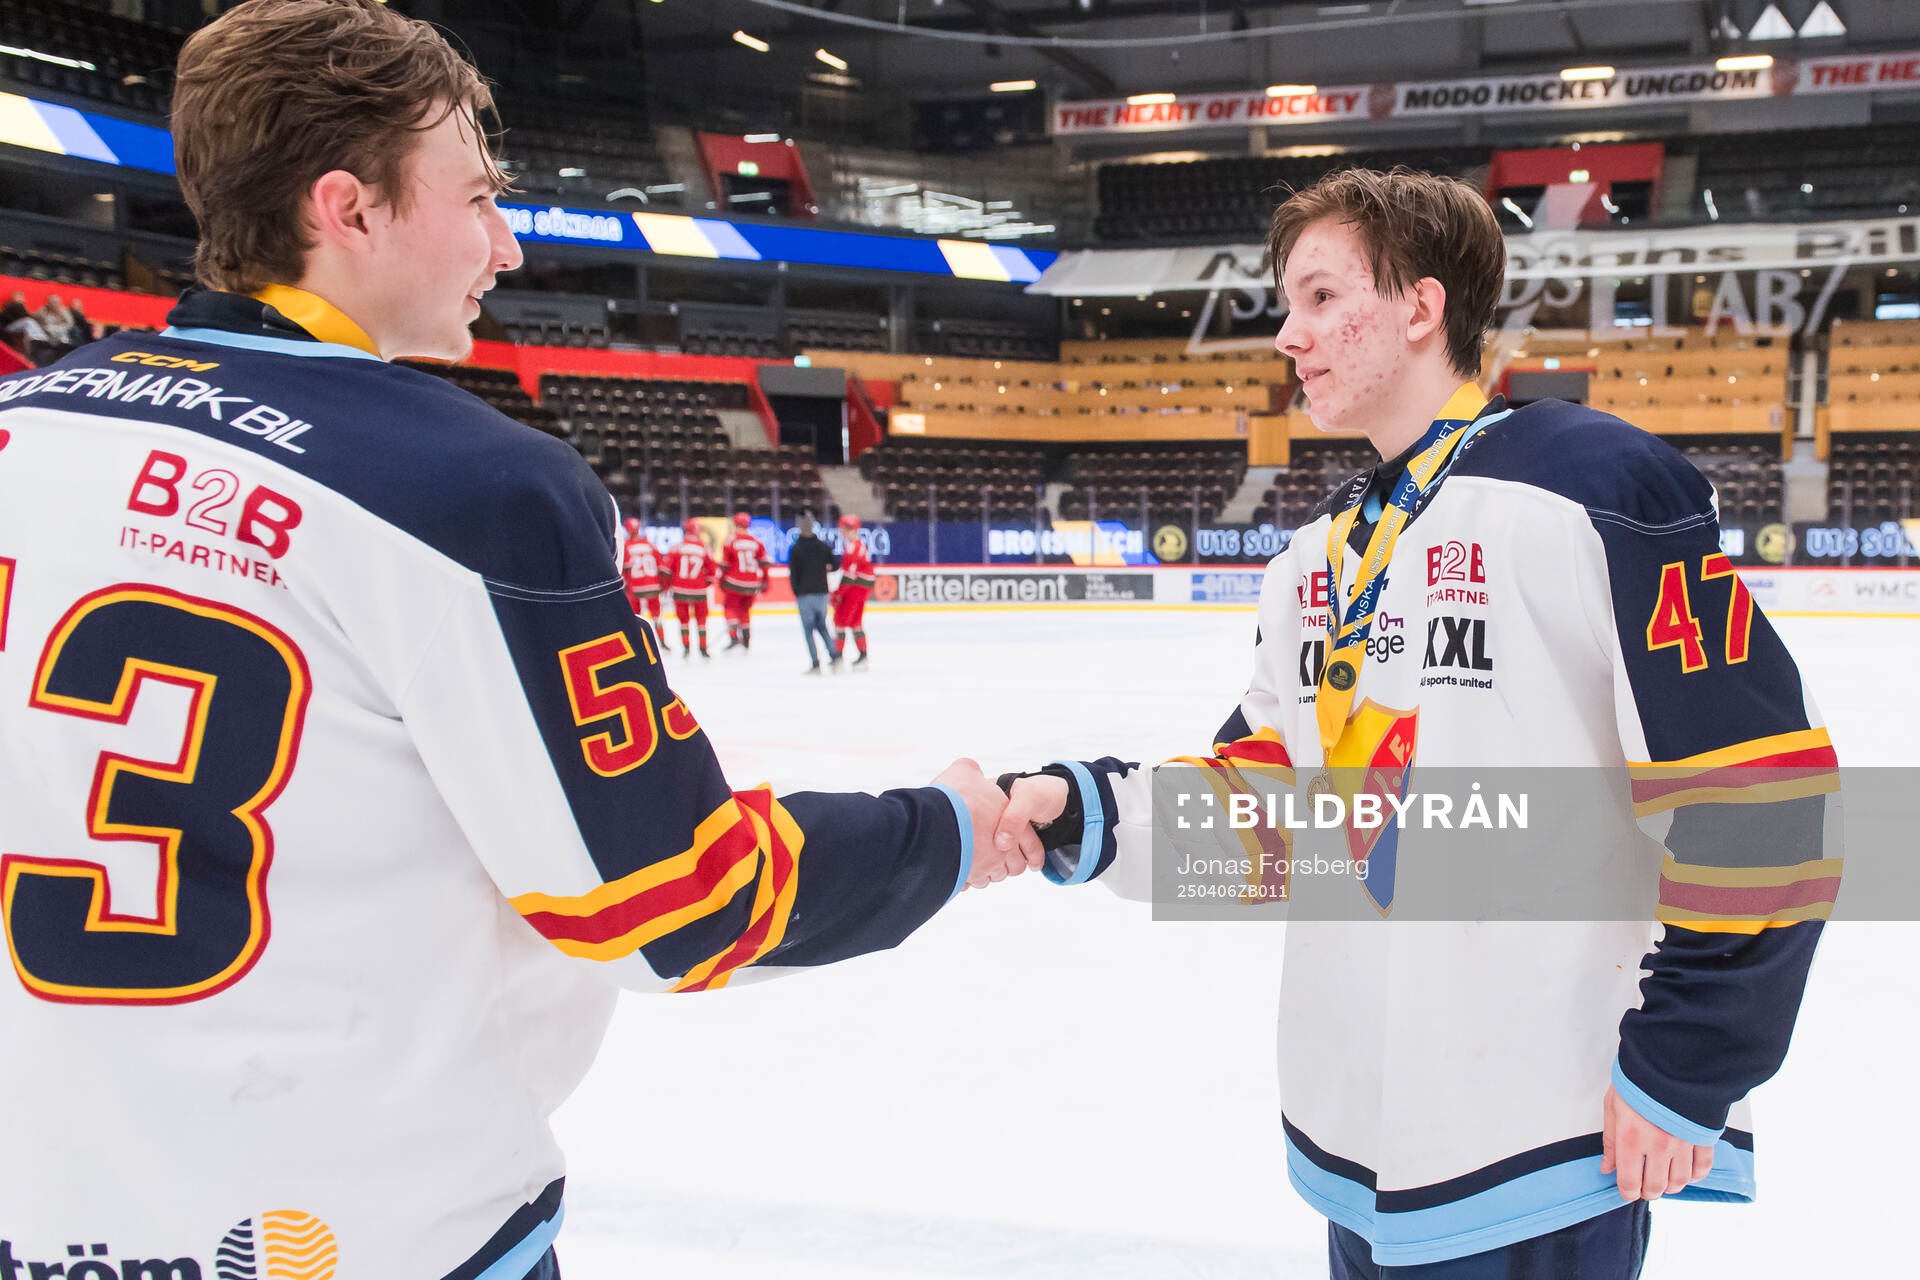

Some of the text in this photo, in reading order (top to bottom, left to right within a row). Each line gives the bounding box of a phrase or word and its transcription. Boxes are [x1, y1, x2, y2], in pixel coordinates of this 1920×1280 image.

[1811, 57, 1920, 86] THE HE
[1404, 68, 1759, 109] MODO HOCKEY UNGDOM
[1059, 91, 1359, 128] THE HEART OF HOCKEY
[110, 351, 221, 373] CCM
[229, 404, 314, 454] BIL
[127, 449, 304, 560] B2B
[1196, 529, 1240, 557] U16
[1806, 527, 1859, 558] U16
[630, 555, 658, 578] 20
[679, 554, 704, 579] 17
[1426, 540, 1486, 587] B2B
[899, 573, 1068, 602] lättelement
[1646, 551, 1754, 674] 47
[1422, 616, 1493, 671] XXL
[1427, 675, 1458, 688] sports
[1459, 676, 1493, 689] united
